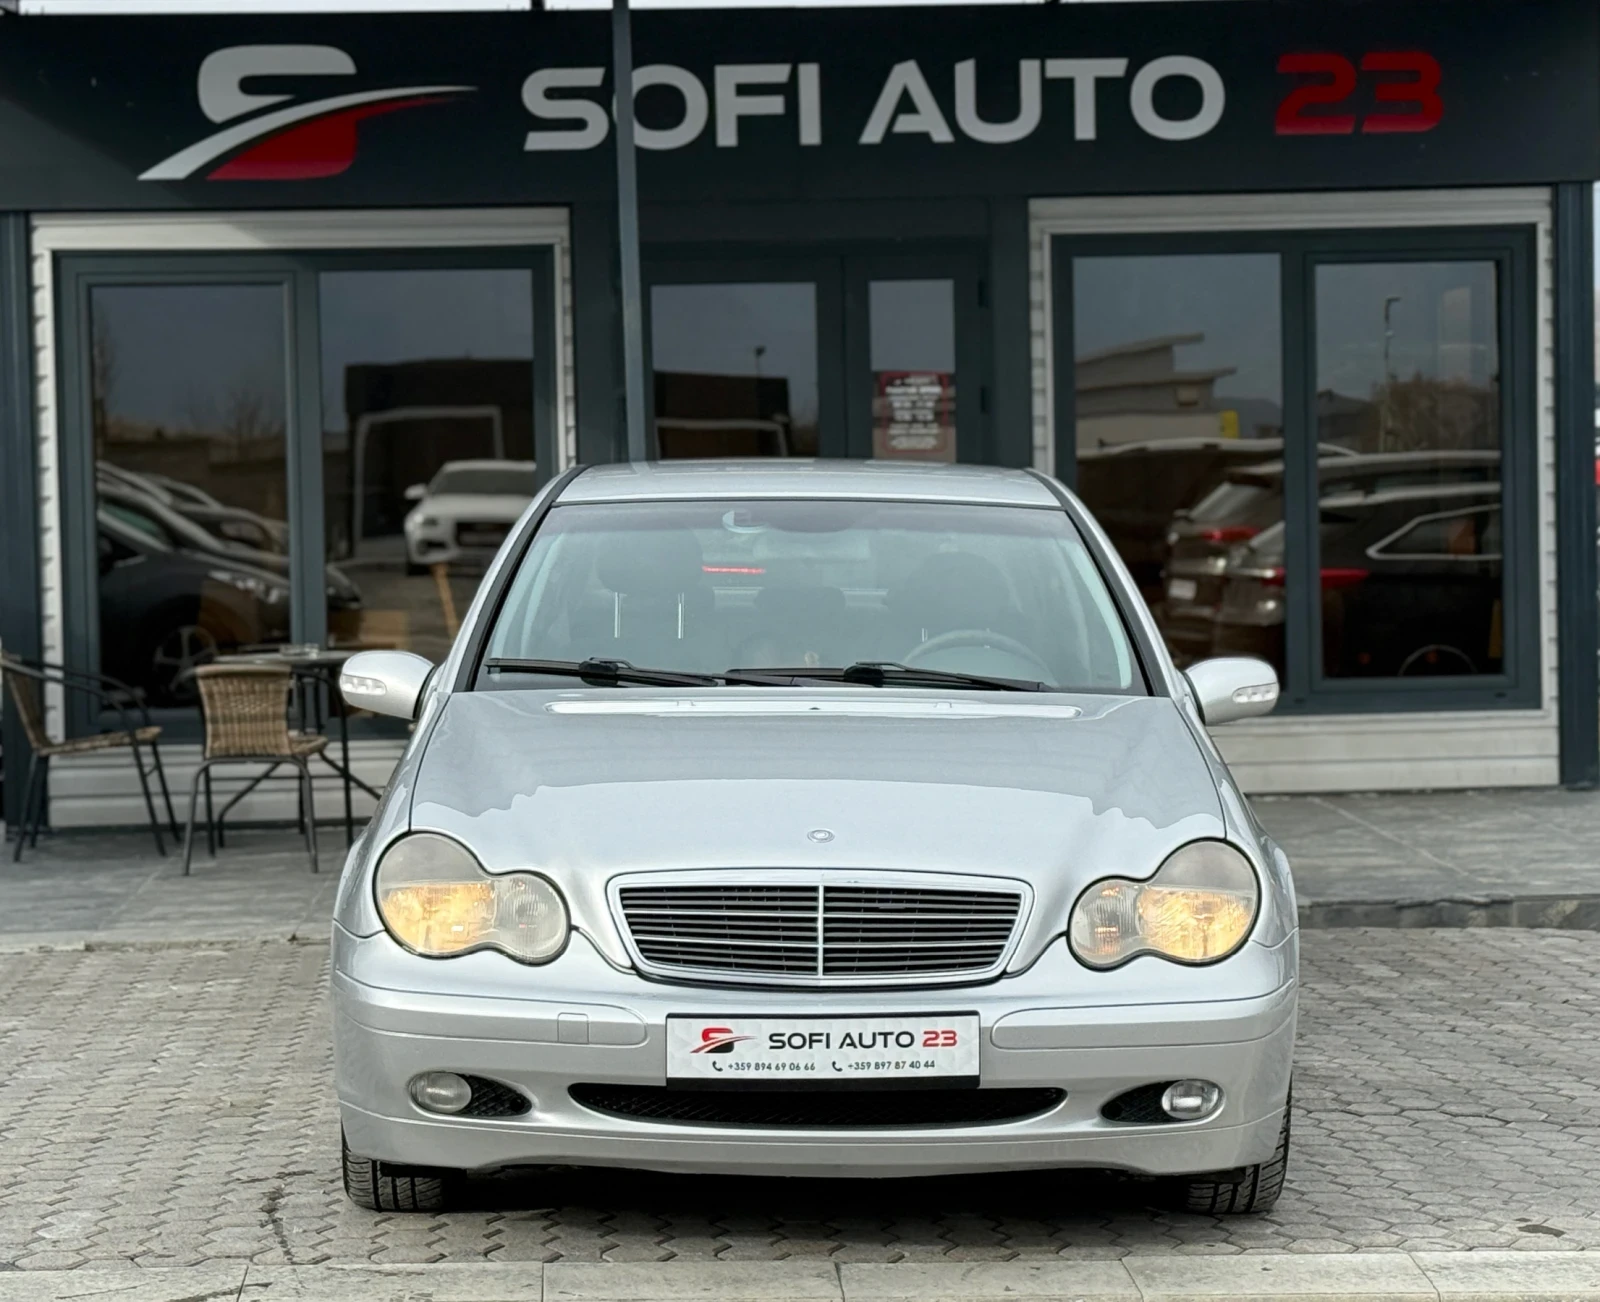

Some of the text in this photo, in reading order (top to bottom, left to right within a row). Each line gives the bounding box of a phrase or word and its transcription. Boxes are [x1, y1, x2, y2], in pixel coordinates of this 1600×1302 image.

[521, 50, 1445, 152] SOFI AUTO 23
[768, 1030, 958, 1050] SOFI AUTO 23
[728, 1062, 816, 1071] +359 894 69 06 66
[847, 1060, 935, 1071] +359 897 87 40 44
